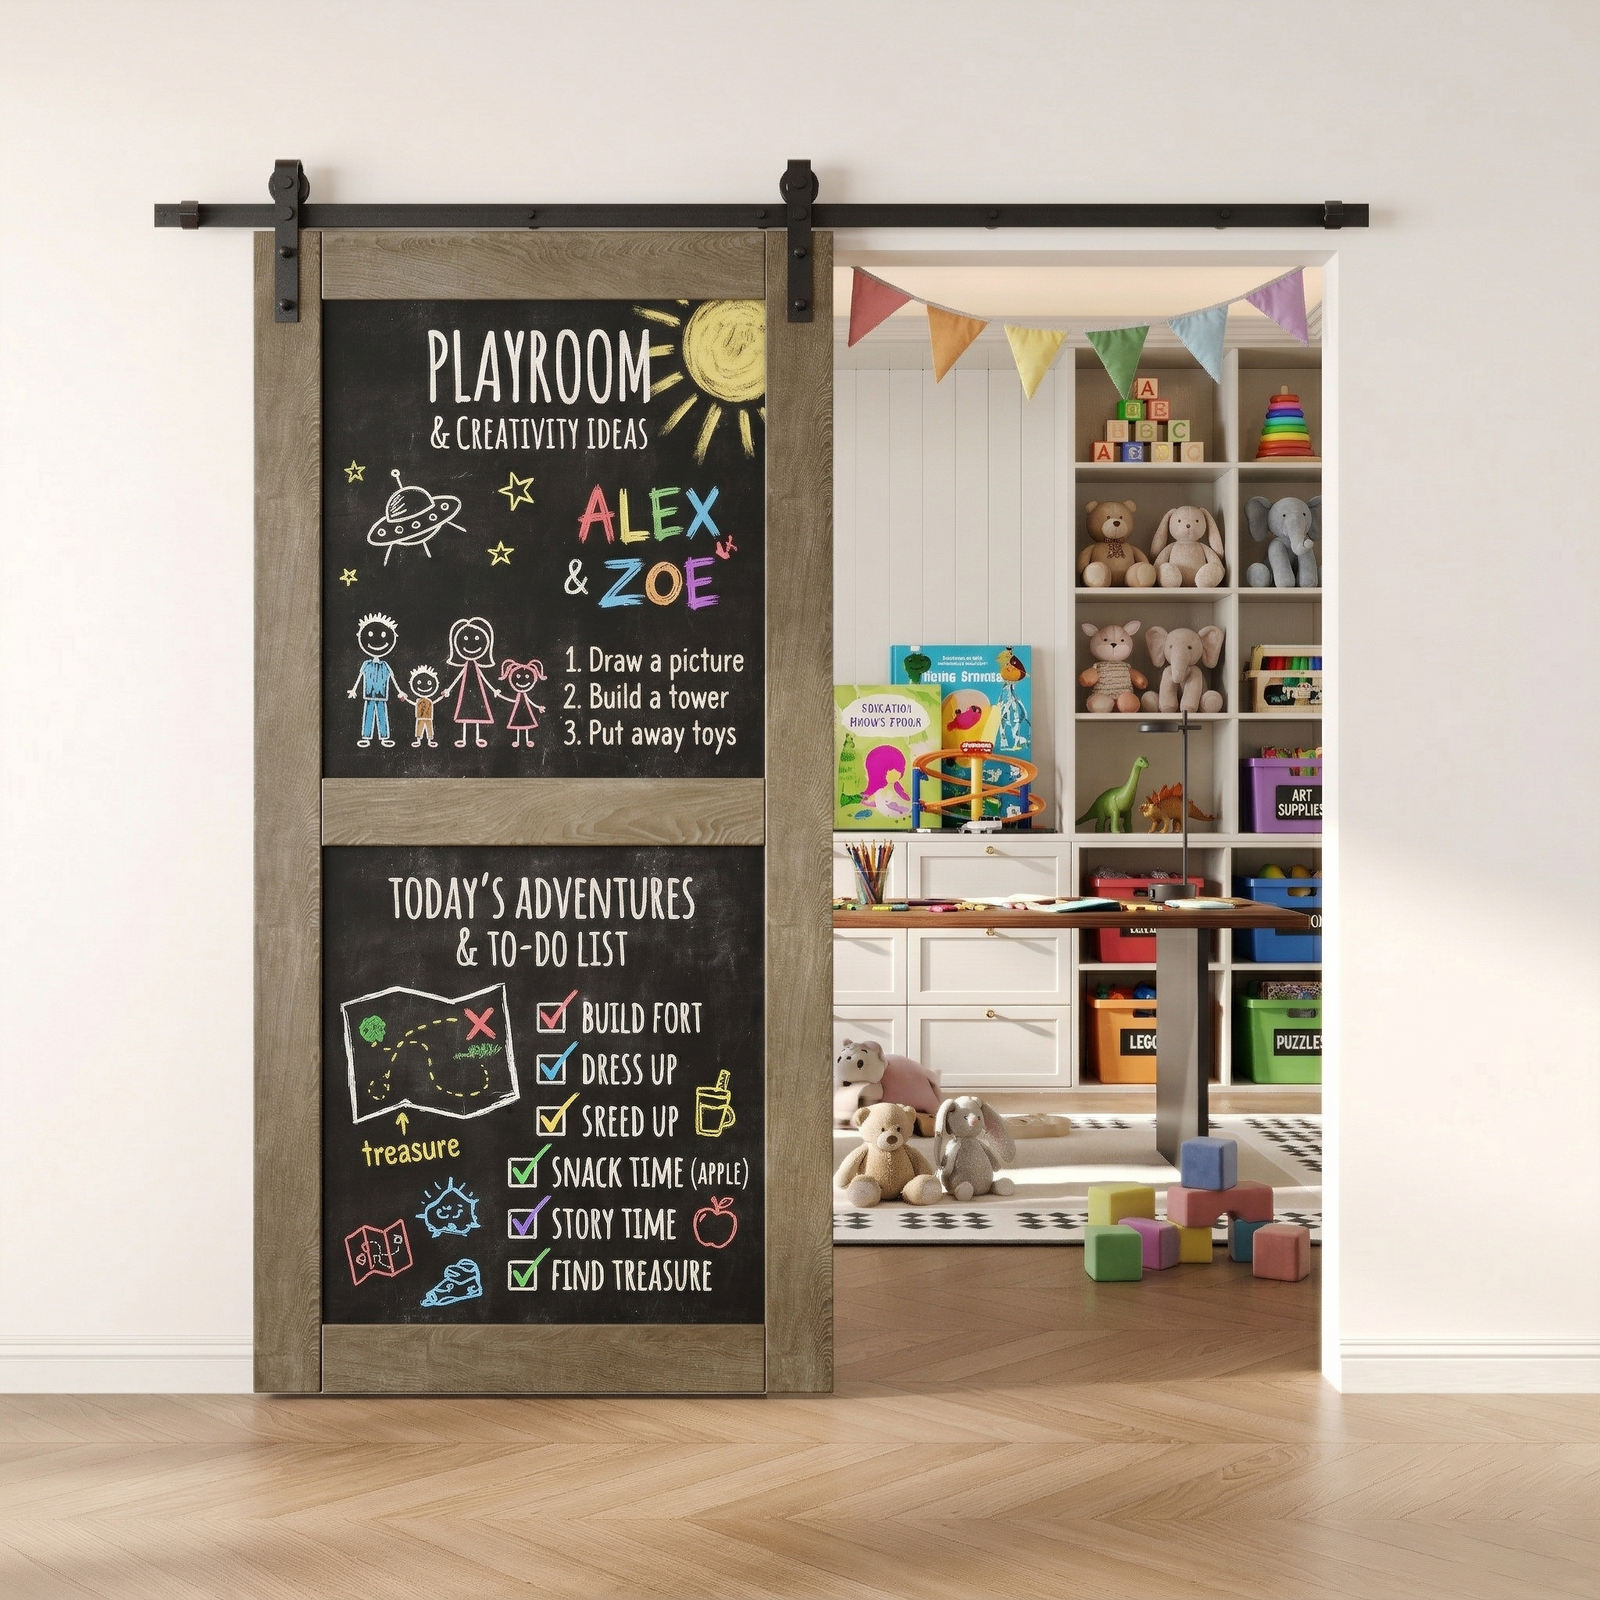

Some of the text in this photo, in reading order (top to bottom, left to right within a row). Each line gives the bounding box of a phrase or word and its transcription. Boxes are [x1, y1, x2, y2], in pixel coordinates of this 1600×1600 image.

[428, 329, 651, 405] PLAYROOM
[1141, 380, 1155, 396] A
[430, 416, 648, 450] & CREATIVITY IDEAS
[1172, 422, 1187, 439] C
[1096, 444, 1111, 460] A
[577, 483, 721, 544] ALEX
[564, 556, 722, 610] & ZOE
[565, 646, 745, 681] 1. Draw a picture
[563, 682, 729, 710] 2. Build a tower
[563, 719, 737, 755] 3. Put away toys
[1291, 788, 1313, 802] ART
[388, 872, 696, 920] TODAY'S ADVENTURES
[456, 927, 628, 967] & TO-DO LIST
[582, 1001, 702, 1034] BUILD FORT
[582, 1053, 678, 1086] DRESS UP
[582, 1104, 679, 1138] SREED UP
[361, 1138, 461, 1167] treasure
[551, 1155, 749, 1190] SNACK TIME (APPLE)
[552, 1207, 677, 1240] STORY TIME
[551, 1259, 713, 1292] FIND TREASURE
